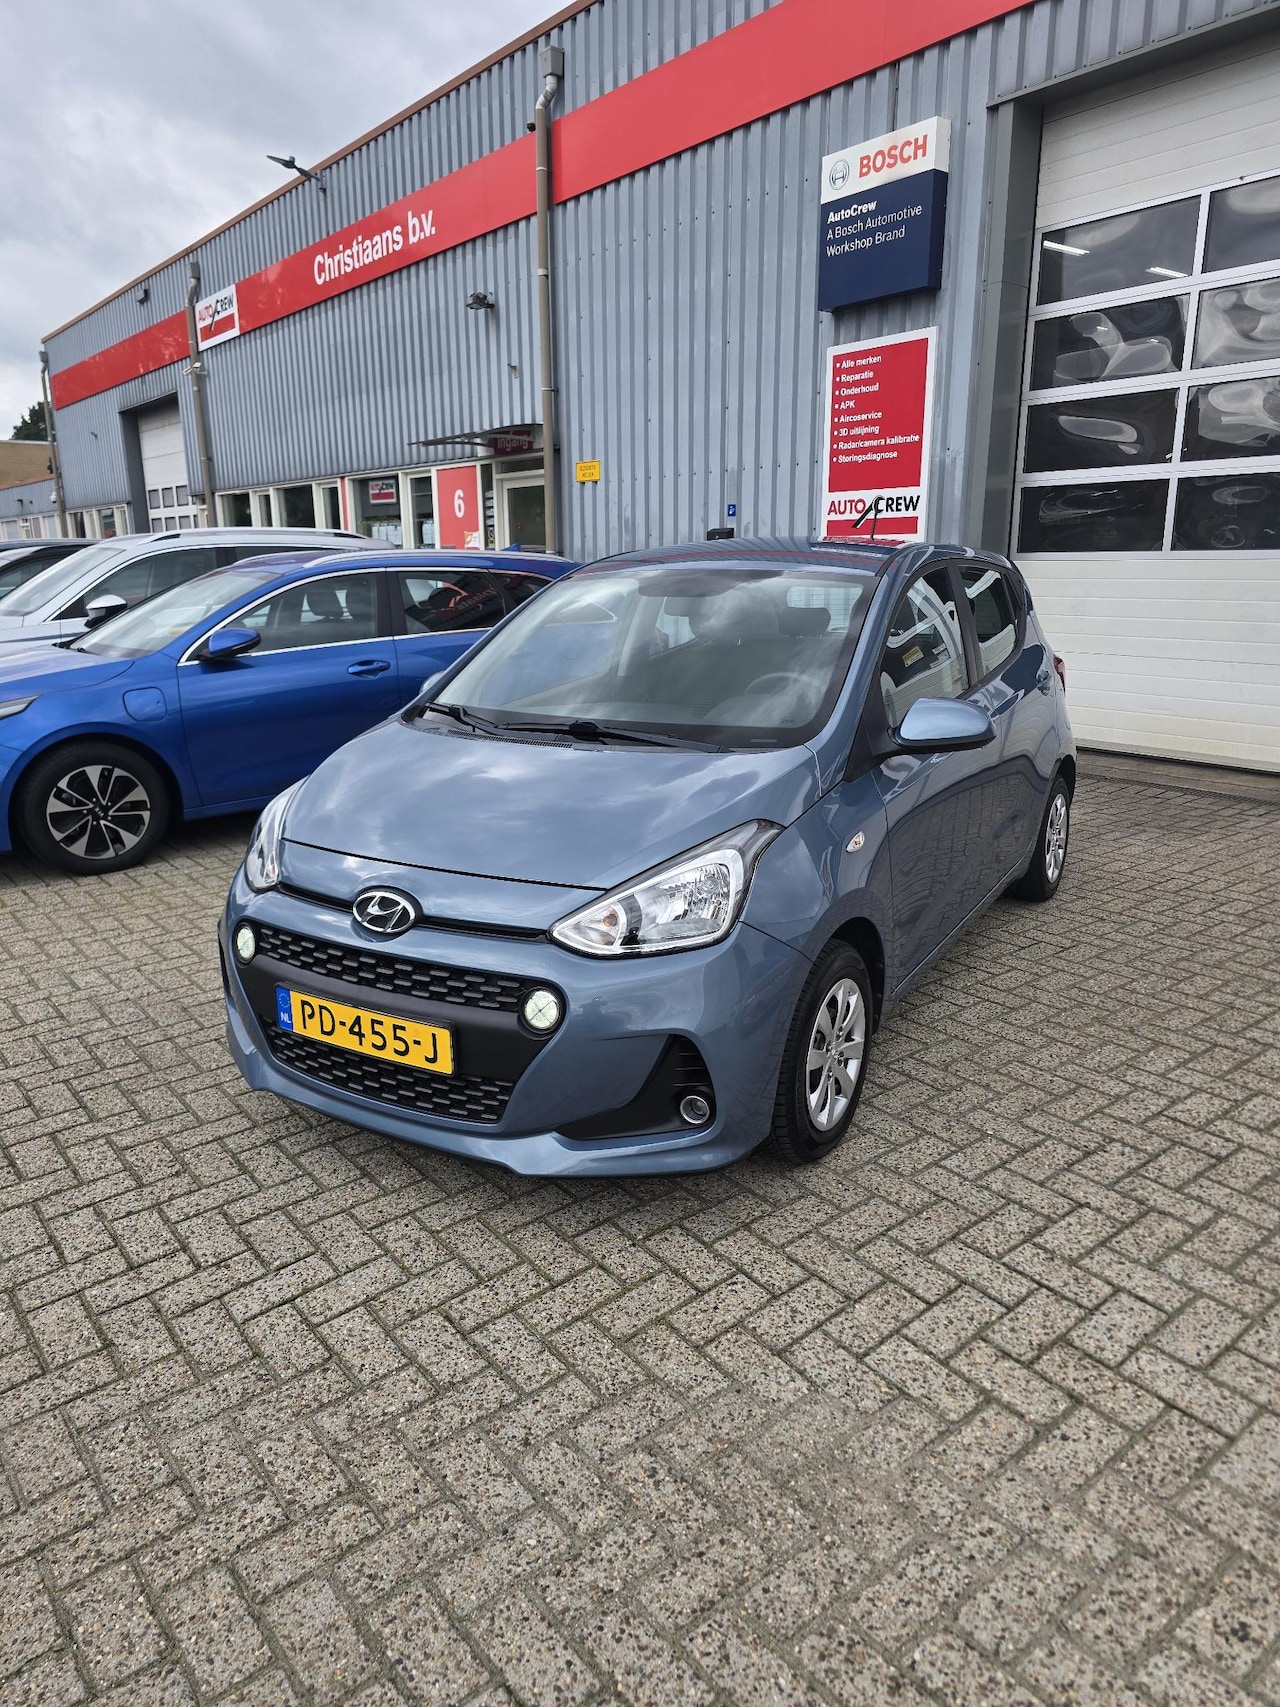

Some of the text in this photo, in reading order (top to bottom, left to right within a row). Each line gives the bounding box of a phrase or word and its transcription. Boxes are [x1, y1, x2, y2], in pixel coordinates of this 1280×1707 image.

[858, 134, 928, 179] BOSCH
[827, 200, 878, 225] AutoCrew
[826, 205, 923, 241] A Bosch Automotive
[313, 209, 437, 286] Christiaans b.v.
[826, 224, 906, 258] Workshop Brand
[841, 355, 882, 369] Alle merken
[841, 370, 874, 383] Reparatie
[840, 382, 879, 396] Onderhoud
[839, 400, 856, 410] APK
[839, 411, 883, 424] Aircoservice
[839, 425, 880, 436] 3D uitlijning
[886, 433, 920, 445] kalibratie
[838, 450, 898, 463] Storingsdiagnose
[453, 489, 465, 519] 6
[280, 1012, 292, 1024] NL
[300, 999, 438, 1064] PD-455-J
